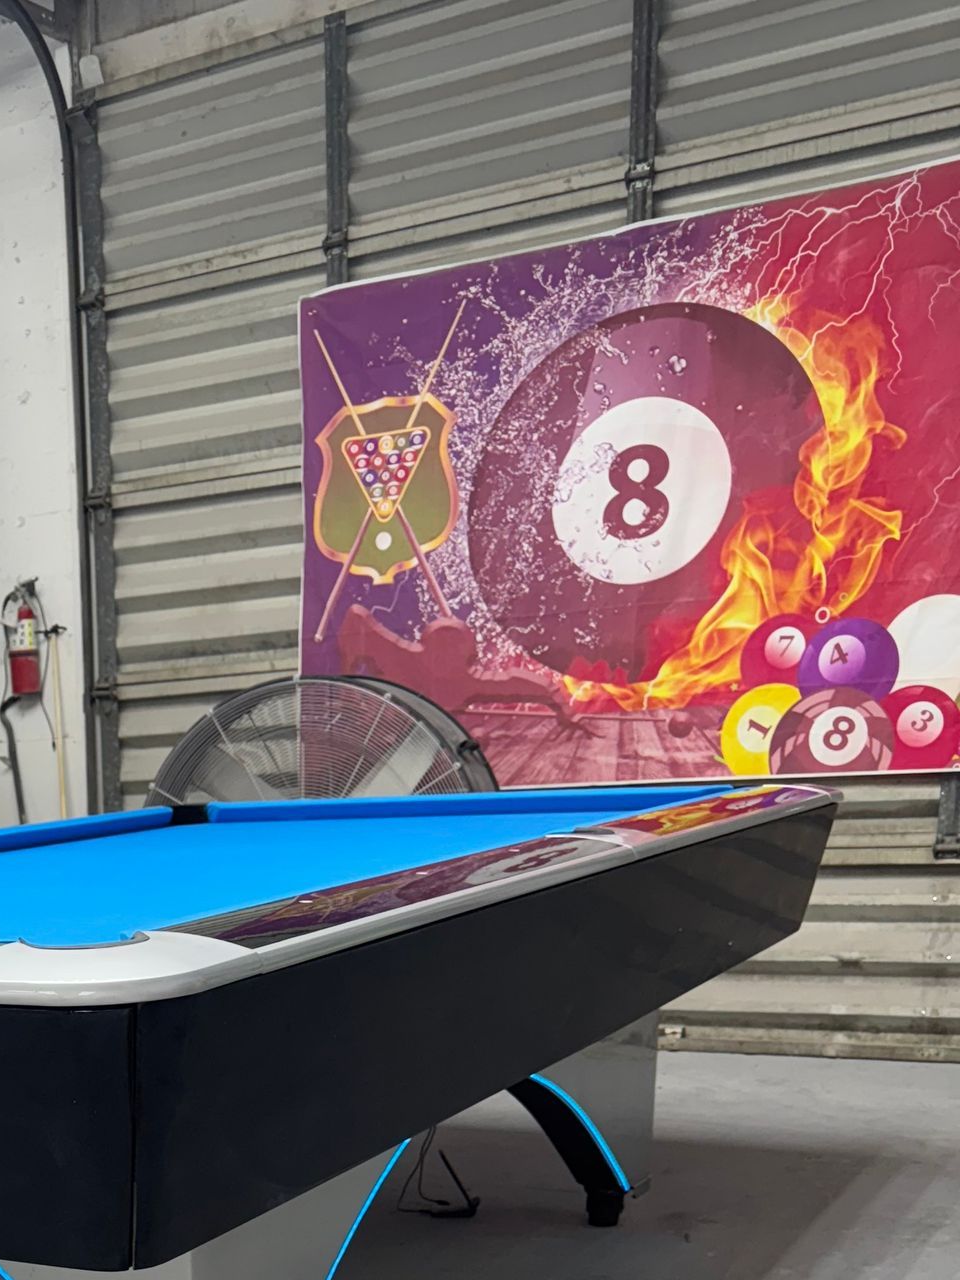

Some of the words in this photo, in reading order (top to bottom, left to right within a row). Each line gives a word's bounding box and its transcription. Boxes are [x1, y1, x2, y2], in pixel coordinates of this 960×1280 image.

[602, 443, 670, 541] 8
[777, 634, 796, 658] 7
[829, 642, 849, 666] 4
[746, 717, 773, 741] 1
[910, 709, 935, 732] 3
[822, 715, 856, 751] 8
